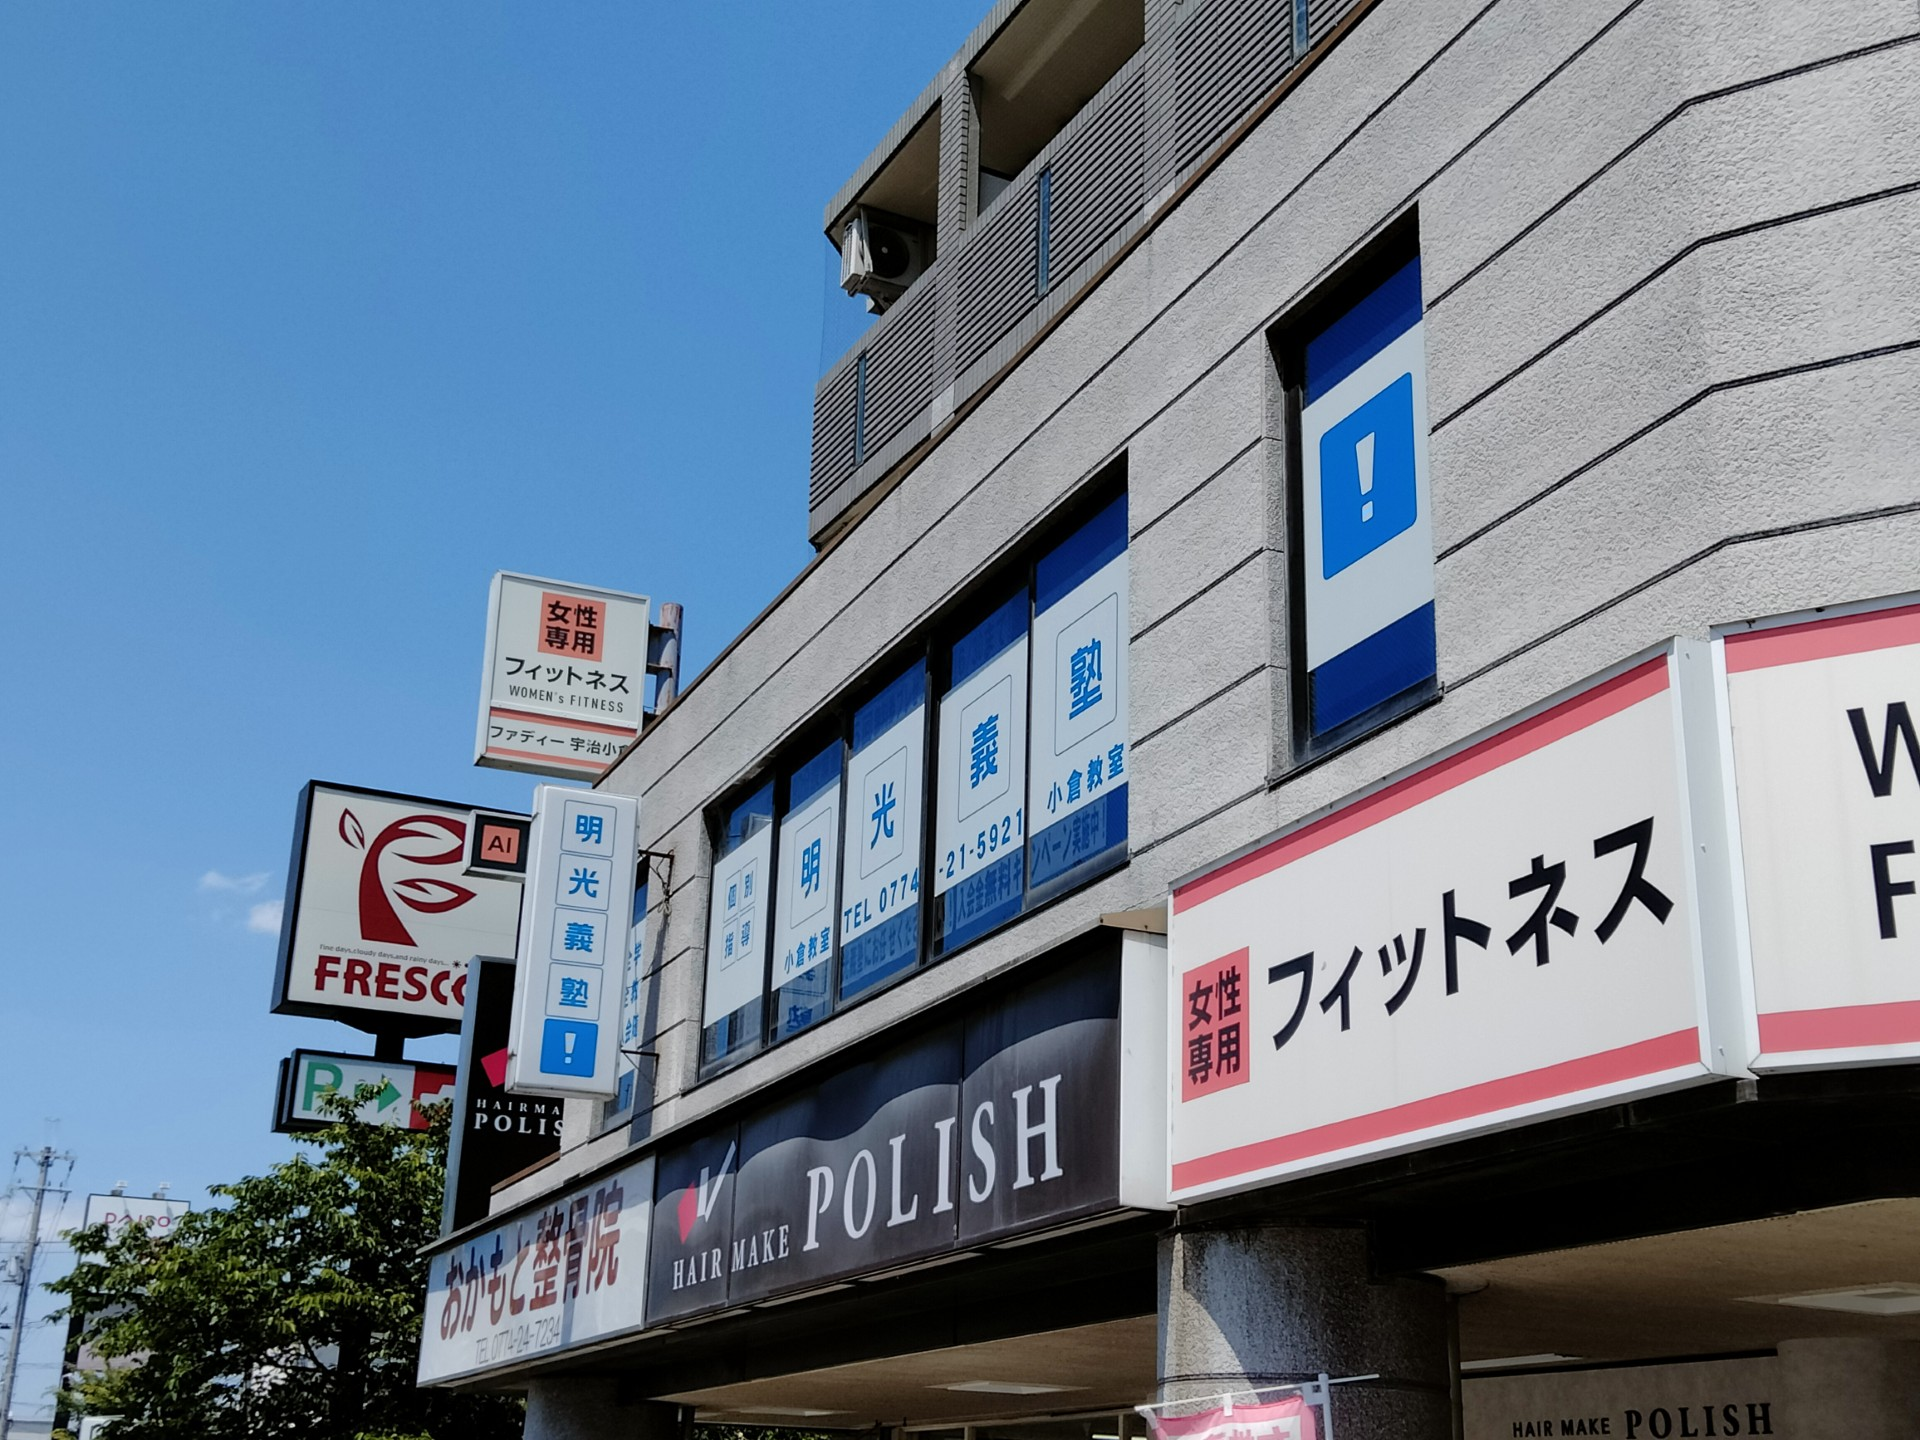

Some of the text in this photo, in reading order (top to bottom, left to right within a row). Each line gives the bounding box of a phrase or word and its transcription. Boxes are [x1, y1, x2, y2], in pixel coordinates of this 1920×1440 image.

[545, 625, 595, 654] 専用
[547, 600, 597, 629] 女性
[505, 657, 629, 694] フィットネス
[570, 695, 624, 713] FITNESS
[491, 726, 565, 746] ファディー
[1047, 743, 1124, 814] 小倉教室
[487, 834, 512, 854] AI
[727, 869, 754, 911] 個別
[844, 808, 1022, 933] TEL 0774 -21-5921
[1869, 840, 1916, 939] F
[558, 814, 604, 1009] 明光義塾
[1268, 816, 1674, 1051] フィットネス
[784, 926, 830, 974] 小倉教室
[1188, 965, 1241, 1031] 女性
[1188, 1021, 1240, 1085] 専用
[302, 1061, 344, 1112] P
[673, 1074, 1063, 1290] HAIR MAKE POLISH
[440, 1179, 623, 1341] おかもと整骨院
[475, 1314, 560, 1365] TEL 0774-24-7234
[1513, 1402, 1774, 1440] HAIR MAKE POLISH
